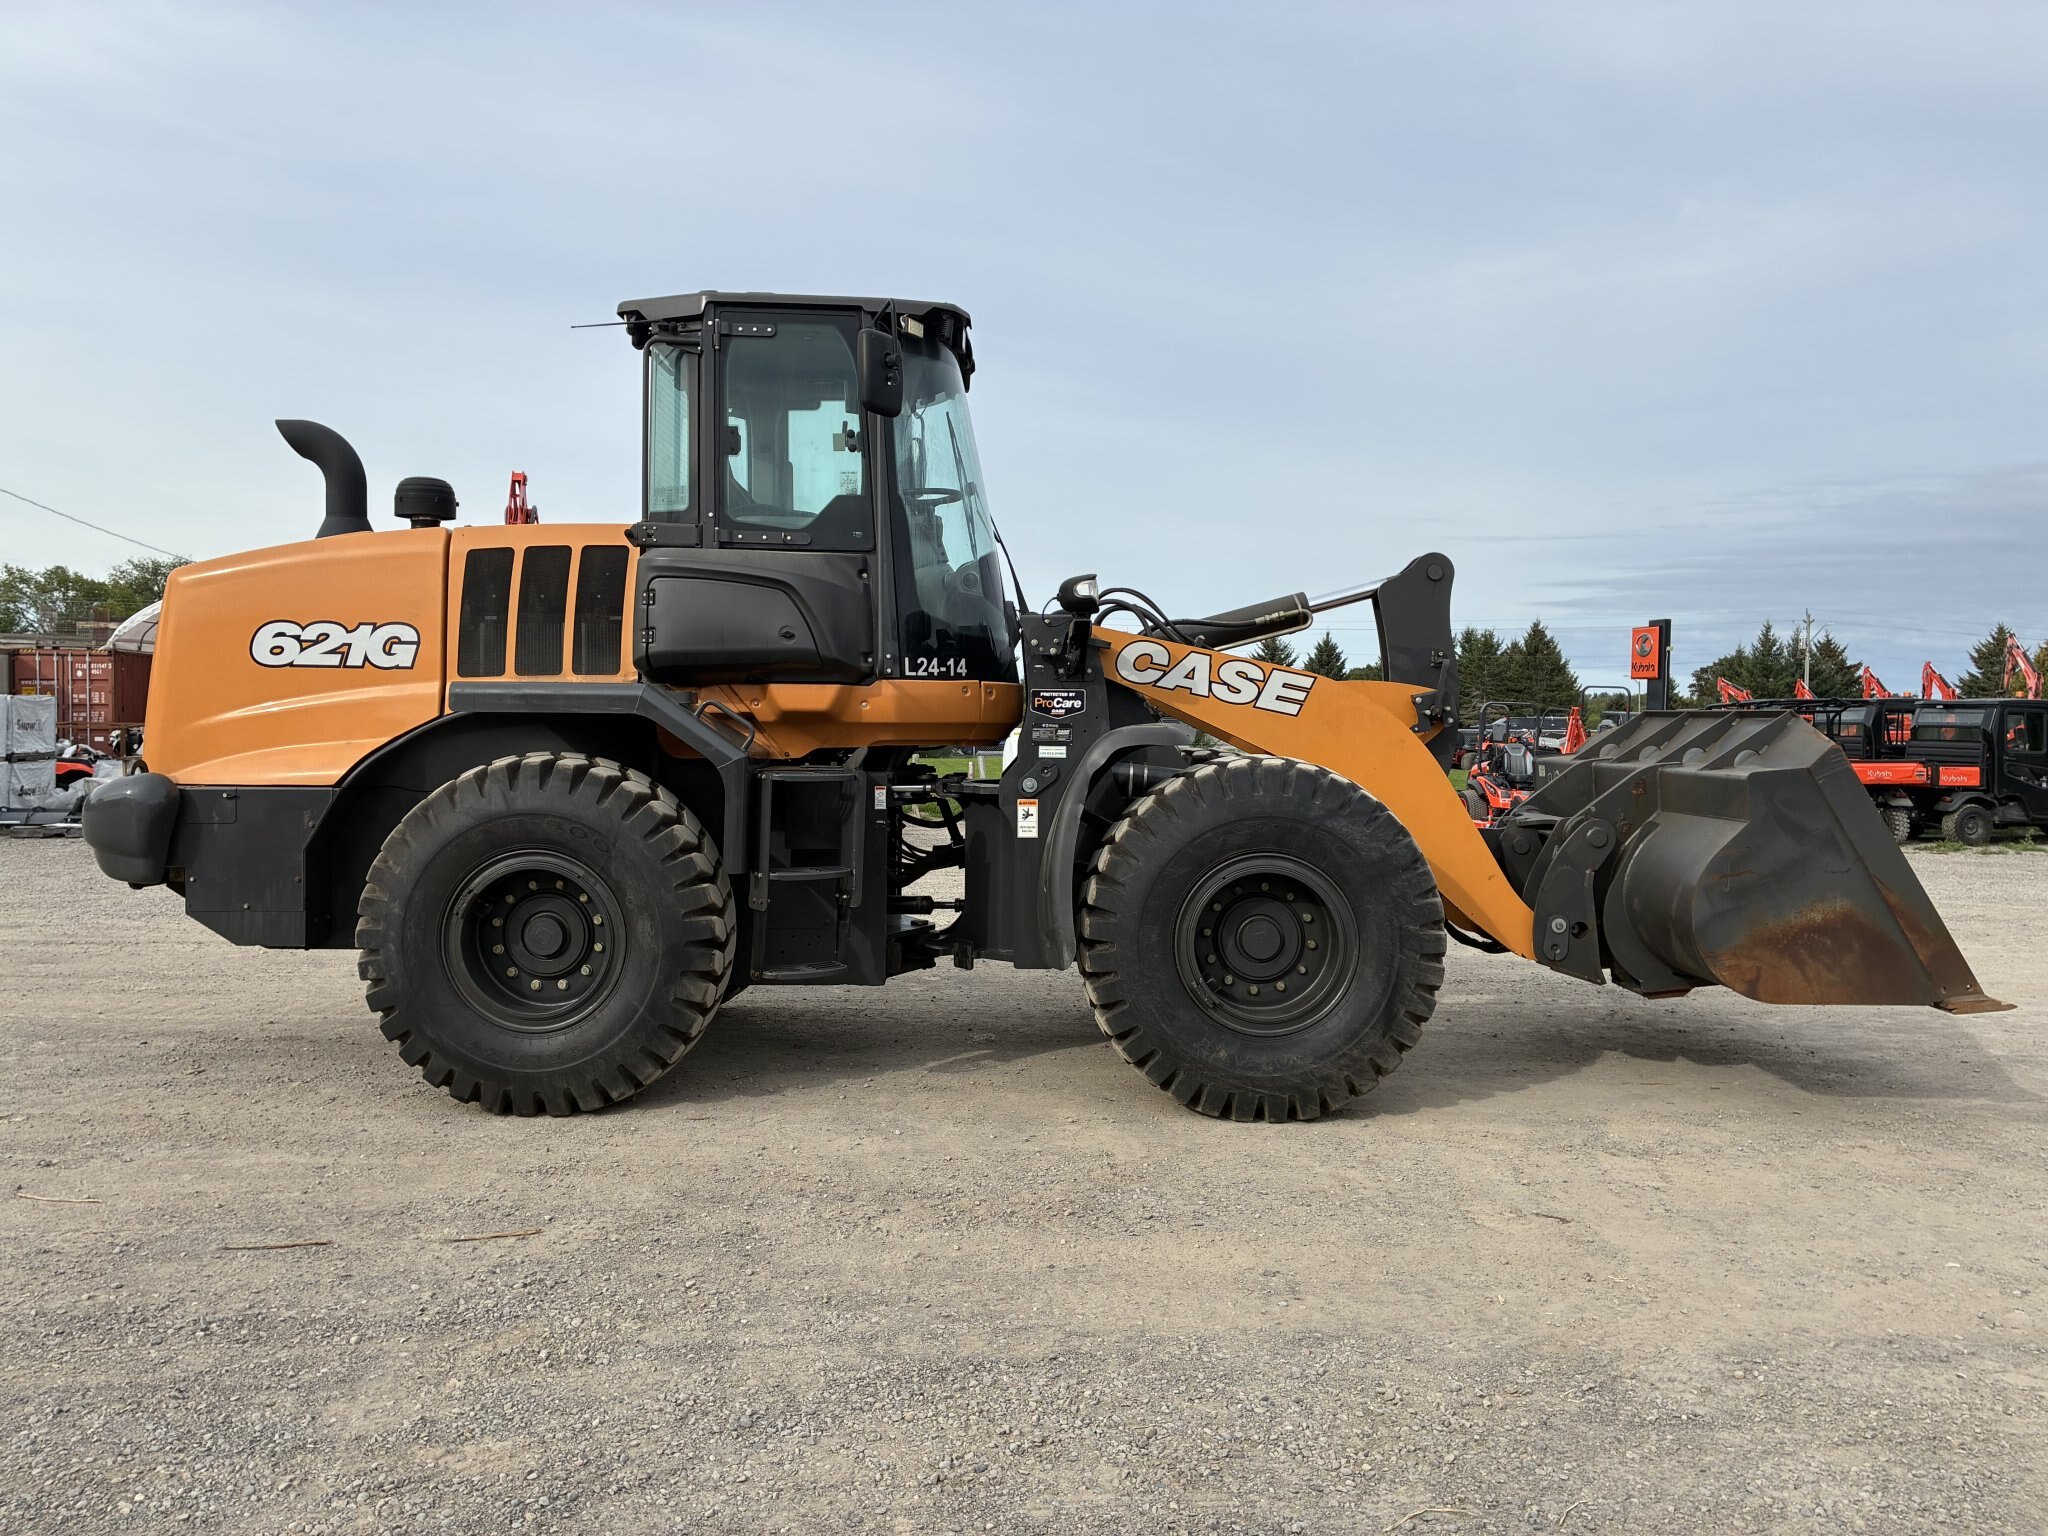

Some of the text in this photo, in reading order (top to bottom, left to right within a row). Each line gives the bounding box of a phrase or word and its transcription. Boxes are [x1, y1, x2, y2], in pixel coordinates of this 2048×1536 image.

[249, 619, 421, 670] 621G
[904, 656, 968, 677] L24-14
[1632, 662, 1655, 672] Kubota
[1114, 639, 1317, 717] CASE
[1034, 697, 1082, 708] ProCare
[1867, 769, 1893, 778] Kubota
[1941, 774, 1968, 783] Kubota
